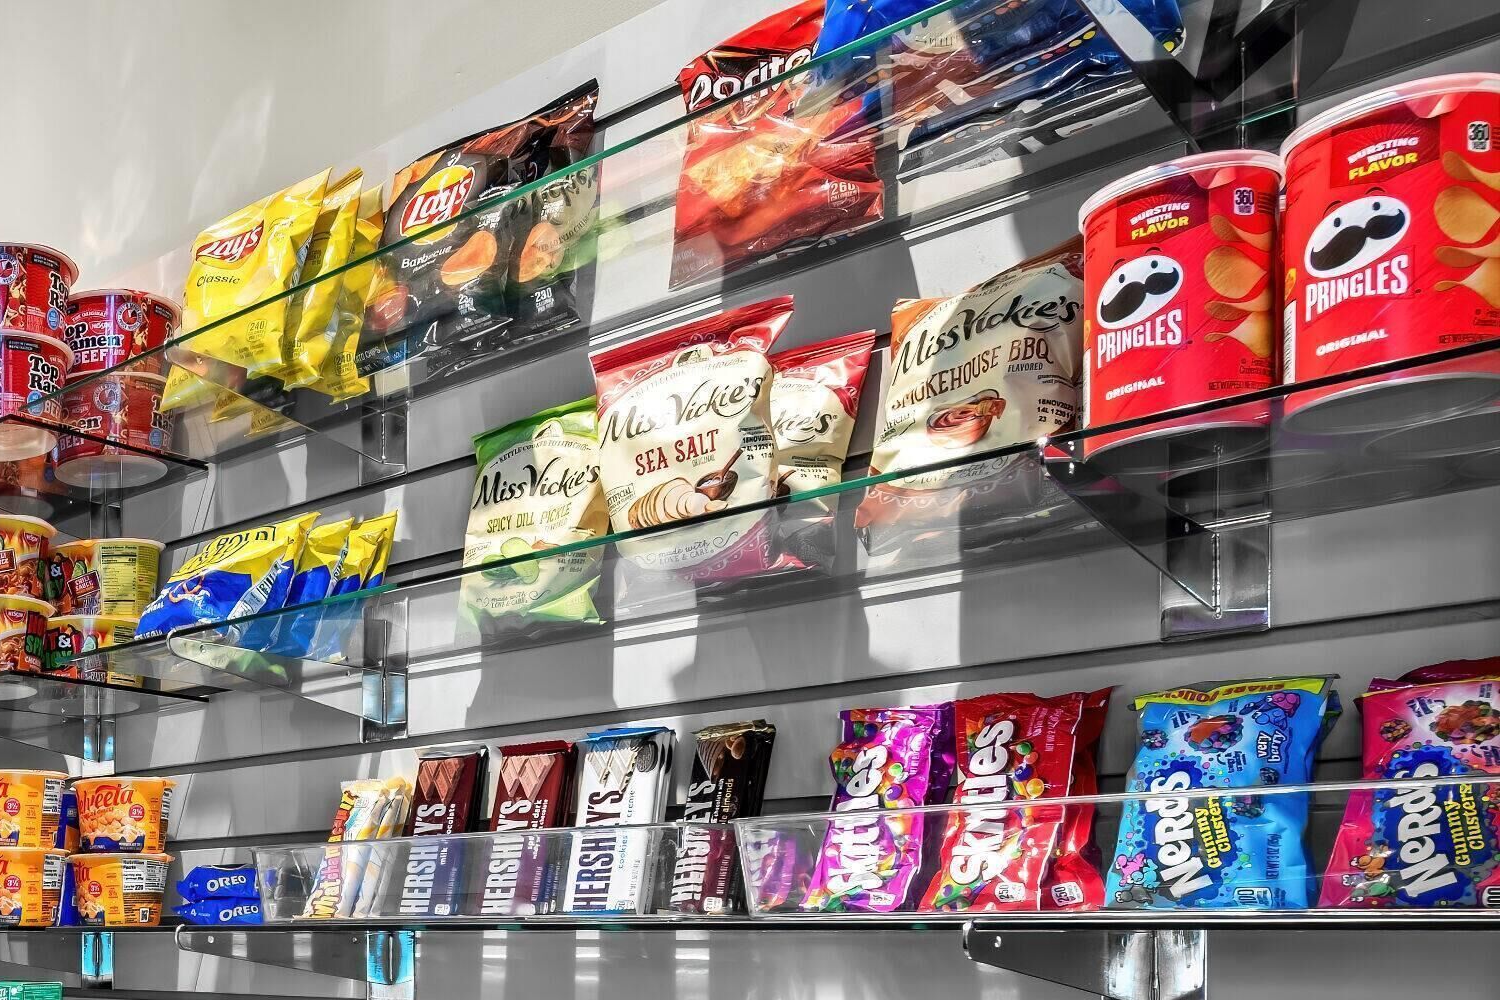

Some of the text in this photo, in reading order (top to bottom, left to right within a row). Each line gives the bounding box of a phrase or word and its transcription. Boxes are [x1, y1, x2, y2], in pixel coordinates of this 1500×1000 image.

[1347, 137, 1420, 163] BURSTING
[1348, 152, 1419, 181] FLAVOR
[405, 176, 470, 227] Lay's
[1235, 188, 1254, 206] 360
[1130, 202, 1190, 226] BURSTING
[1131, 216, 1189, 240] FLAVOR
[1147, 214, 1173, 225] WITH
[197, 222, 263, 262] Lay's
[401, 245, 452, 270] Barbecue
[196, 272, 240, 288] Classic
[1305, 254, 1409, 322] PRINGLES
[892, 289, 1081, 386] Miss Vickie's
[1007, 337, 1054, 365] BBQ
[1097, 309, 1182, 369] PRINGLES
[1316, 329, 1390, 357] ORIGINAL
[30, 355, 58, 381] Top
[74, 350, 108, 364] BEEF
[1007, 362, 1044, 374] FLAVORED
[667, 376, 767, 426] Vickie's
[1105, 376, 1165, 400] ORIGINAL
[635, 428, 719, 477] SEA SALT
[472, 456, 600, 510] Miss Vickie's
[486, 502, 572, 534] SPICY DILL PICKLE
[1257, 731, 1272, 758] very
[1268, 730, 1286, 763] berry
[722, 778, 734, 812] almonds
[1195, 807, 1222, 869] Gummy
[1444, 799, 1471, 866] Gummy
[206, 874, 247, 892] OREO
[1054, 886, 1070, 904] 250
[218, 904, 259, 922] OREO
